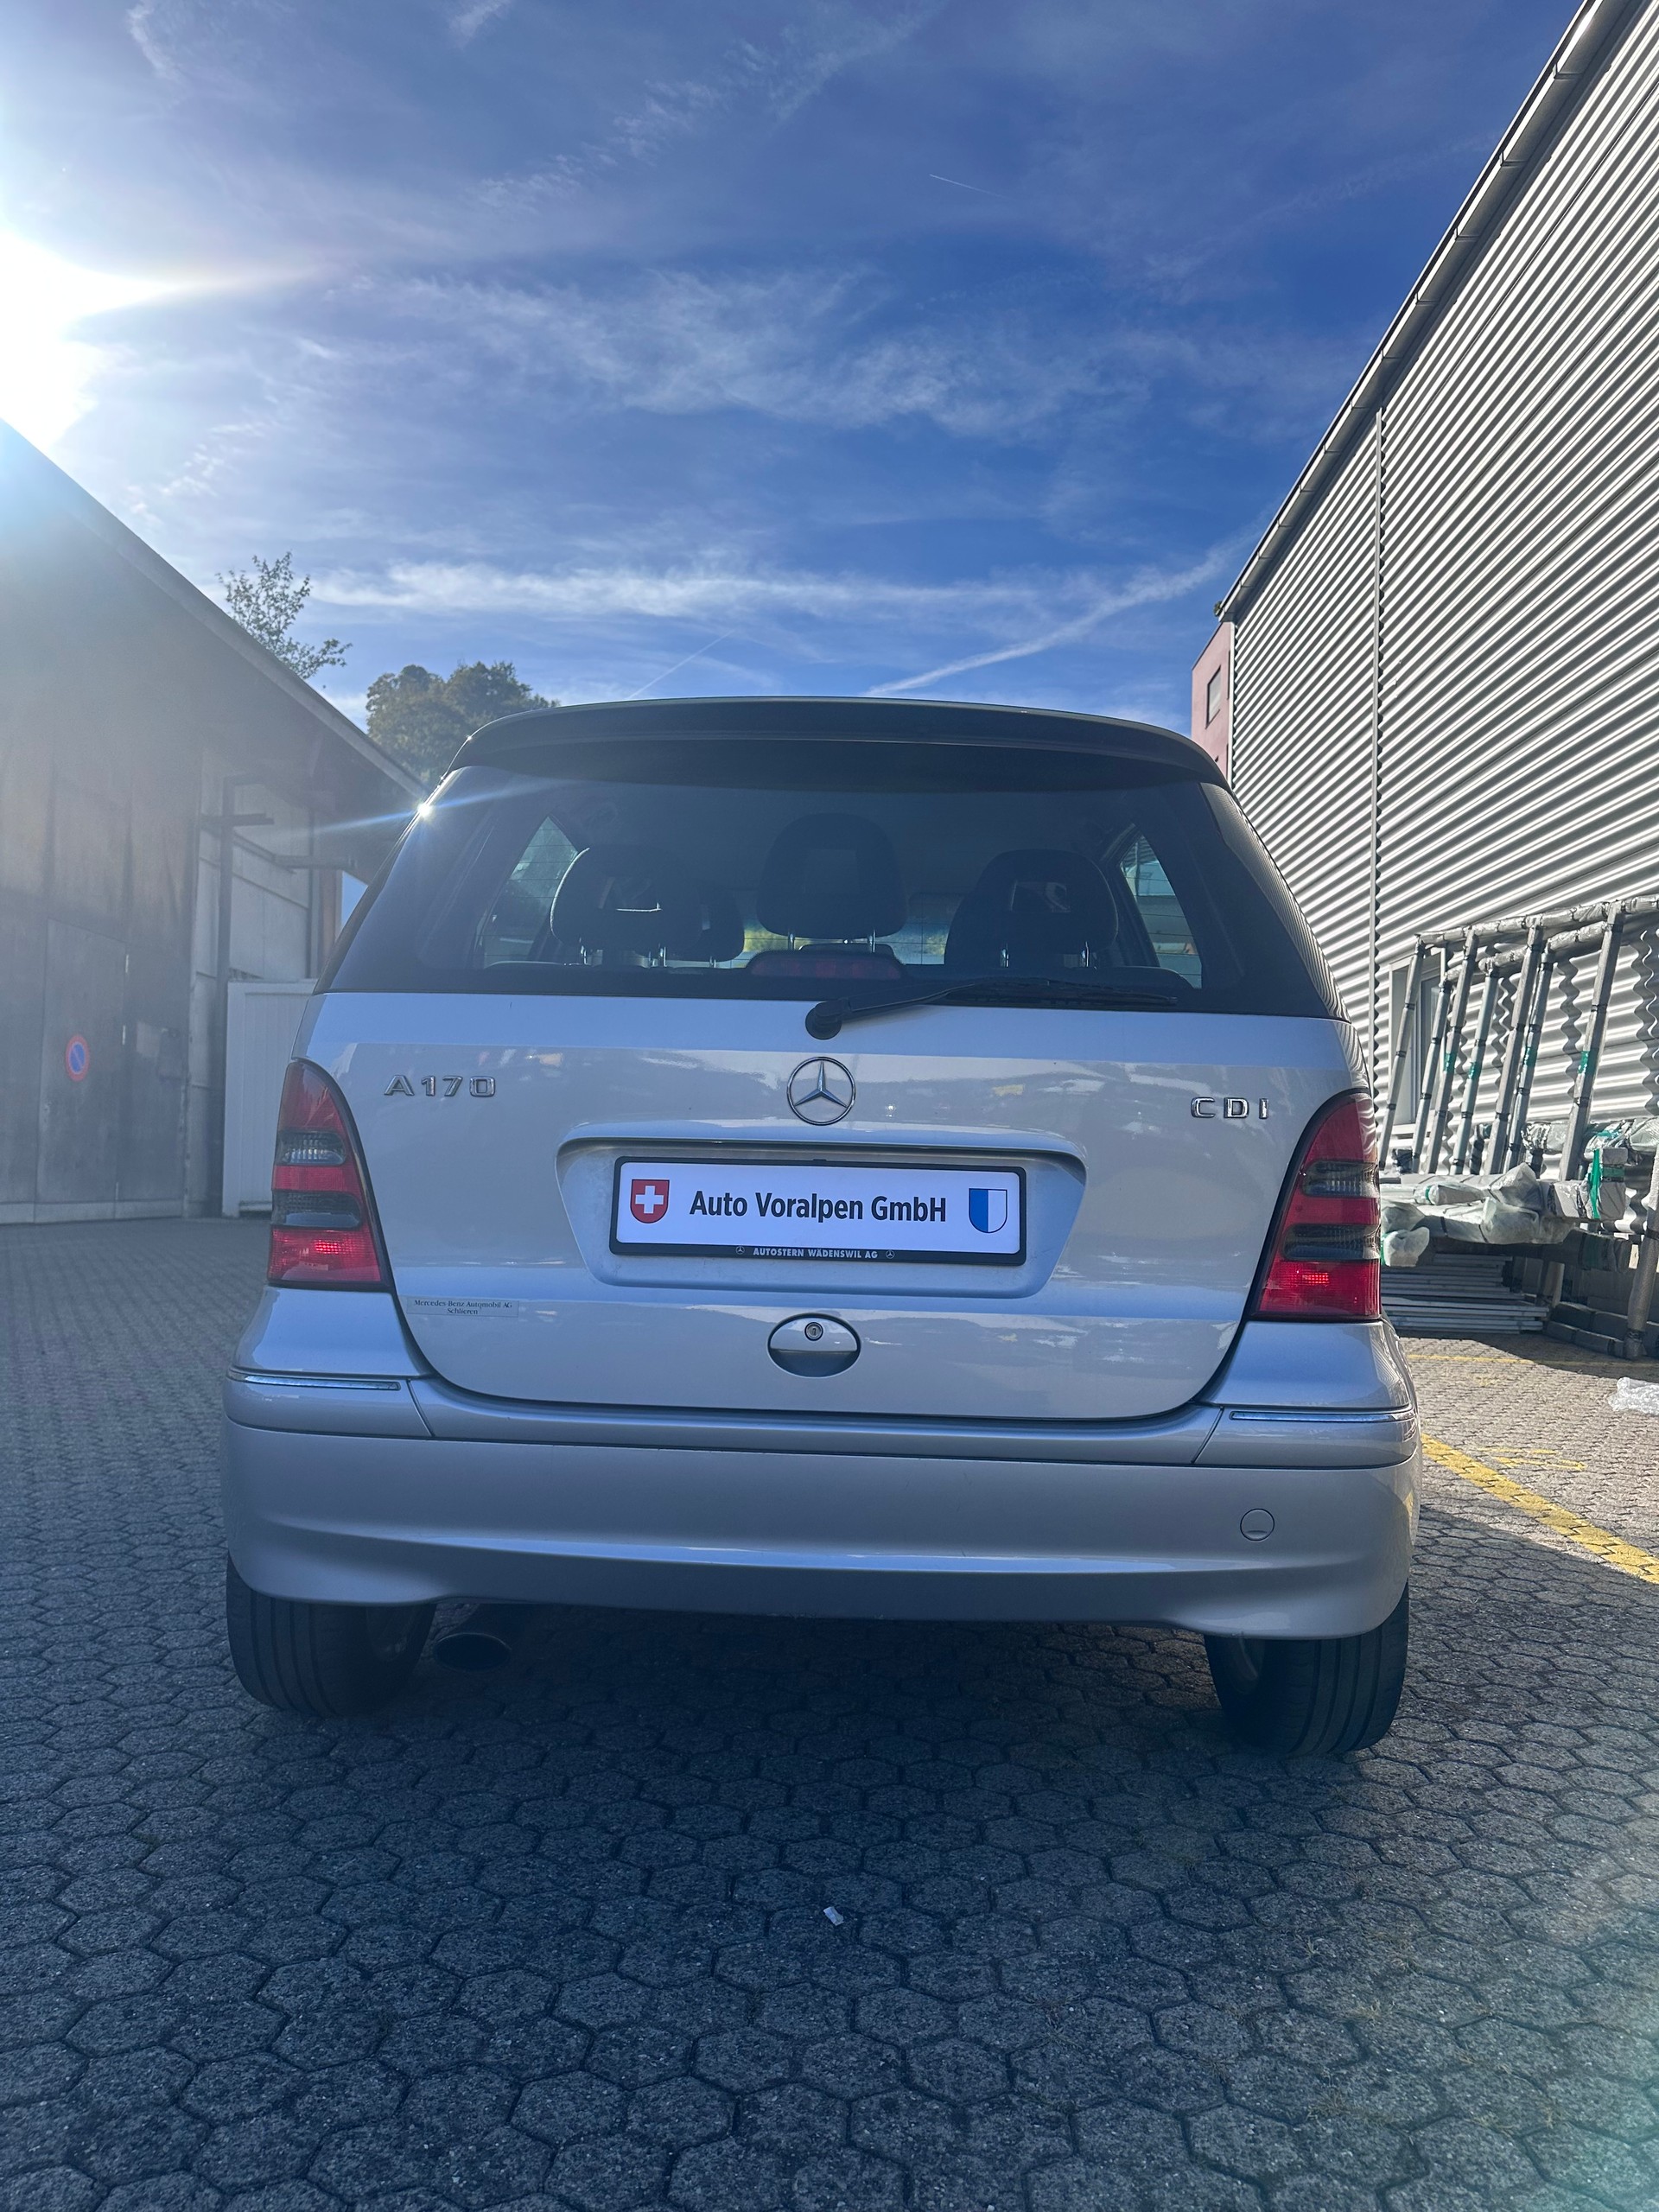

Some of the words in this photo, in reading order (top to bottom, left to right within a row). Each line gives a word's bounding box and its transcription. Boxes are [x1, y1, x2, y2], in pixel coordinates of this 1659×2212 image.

[384, 1074, 496, 1098] A170
[1191, 1096, 1270, 1120] CDI
[690, 1191, 748, 1217] Auto
[755, 1192, 863, 1224] Voralpen
[870, 1196, 947, 1222] GmbH
[753, 1247, 804, 1257] AUTOSTERN
[808, 1248, 862, 1259] WÄDENSWIL
[864, 1250, 879, 1259] AG
